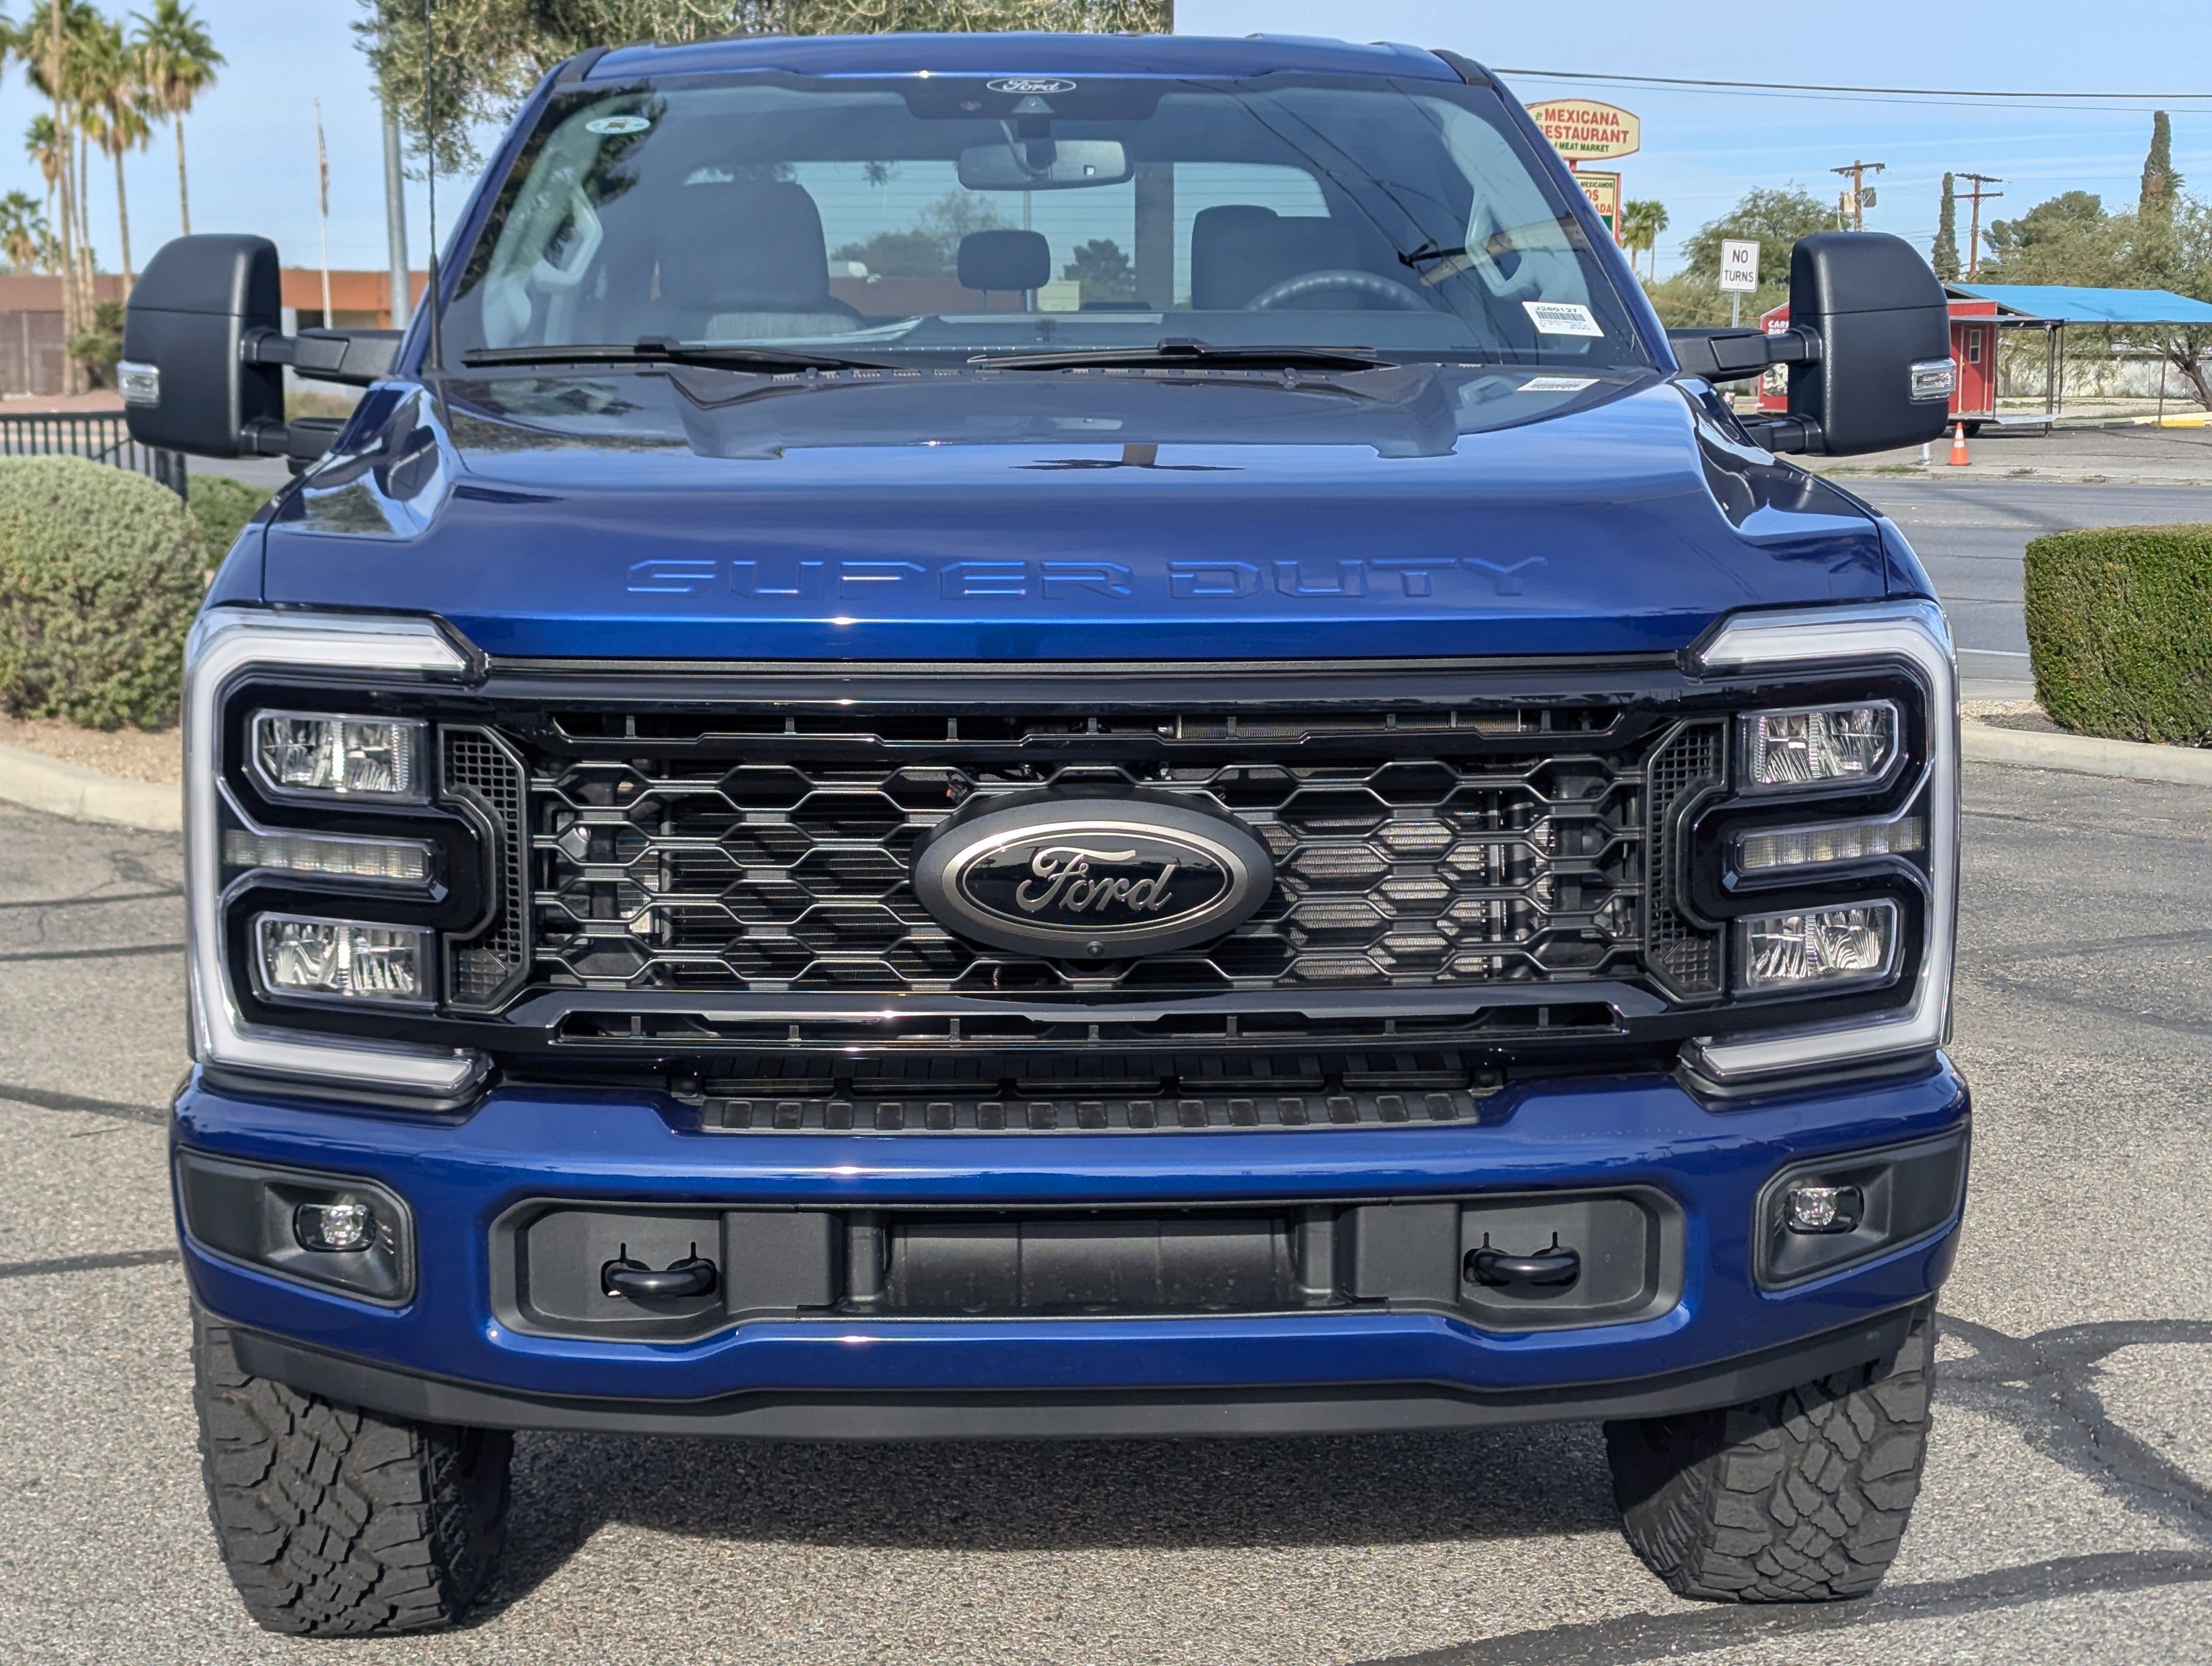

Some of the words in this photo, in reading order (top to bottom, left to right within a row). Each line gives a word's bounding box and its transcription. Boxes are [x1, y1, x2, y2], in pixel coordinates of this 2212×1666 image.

[1002, 80, 1060, 91] Ford
[1544, 108, 1620, 126] MEXICANA
[1559, 142, 1579, 151] MEAT
[1580, 143, 1610, 152] MARKET
[1732, 249, 1748, 264] NO
[1724, 270, 1754, 283] TURNS
[626, 559, 1132, 600] SUPER
[1167, 556, 1548, 599] DUTY
[1015, 846, 1176, 912] Ford
